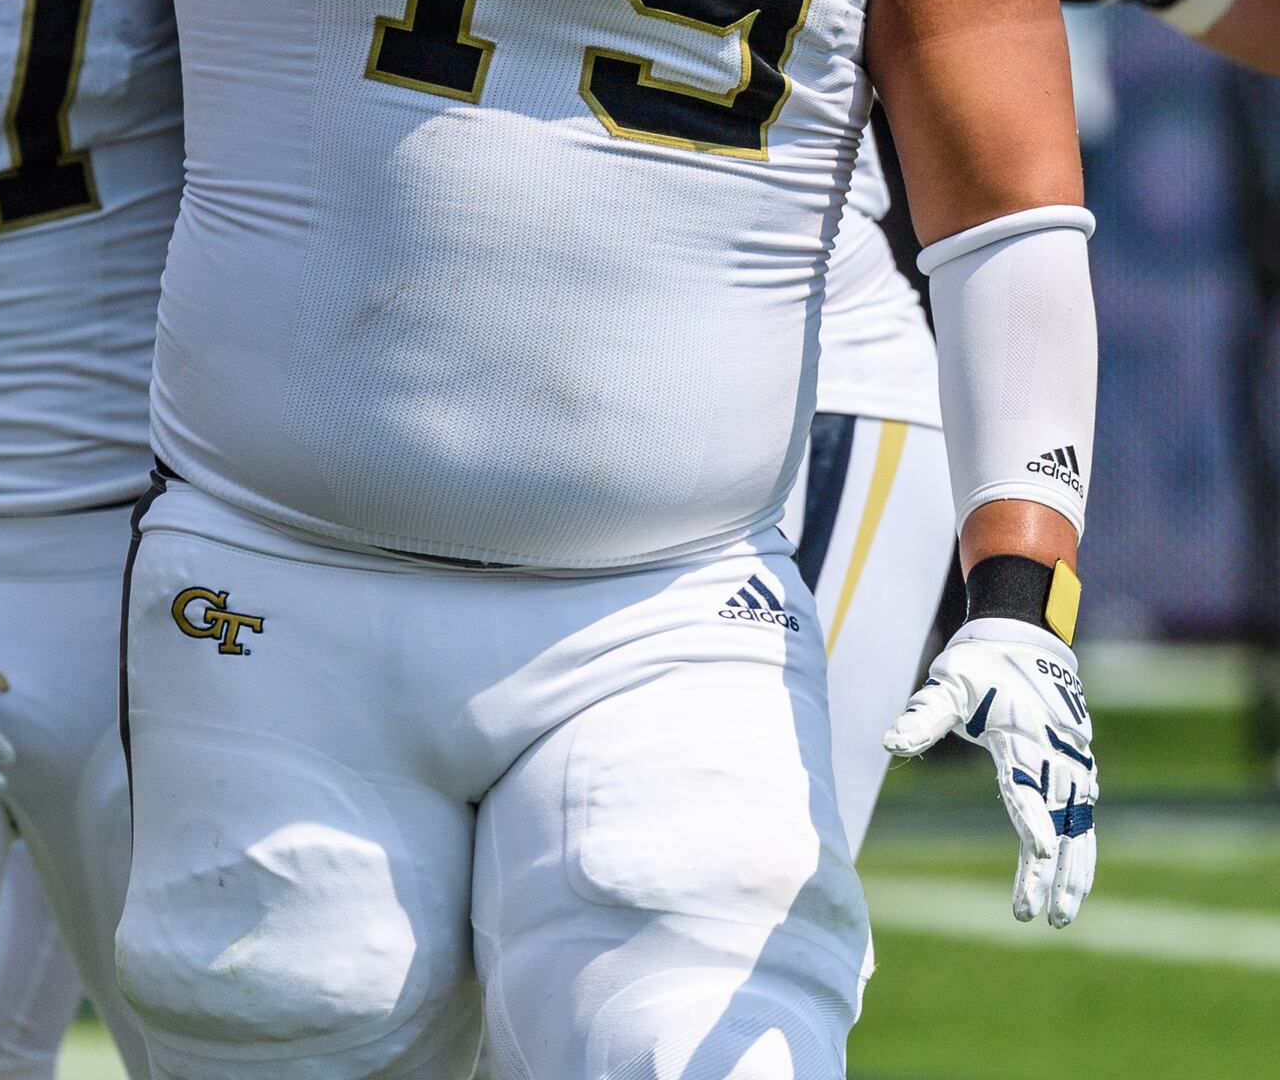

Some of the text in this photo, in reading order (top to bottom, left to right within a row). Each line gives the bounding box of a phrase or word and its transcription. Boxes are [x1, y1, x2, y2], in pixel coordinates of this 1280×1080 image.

[1025, 460, 1085, 500] adidas
[170, 586, 265, 656] GT
[718, 606, 800, 632] adidas
